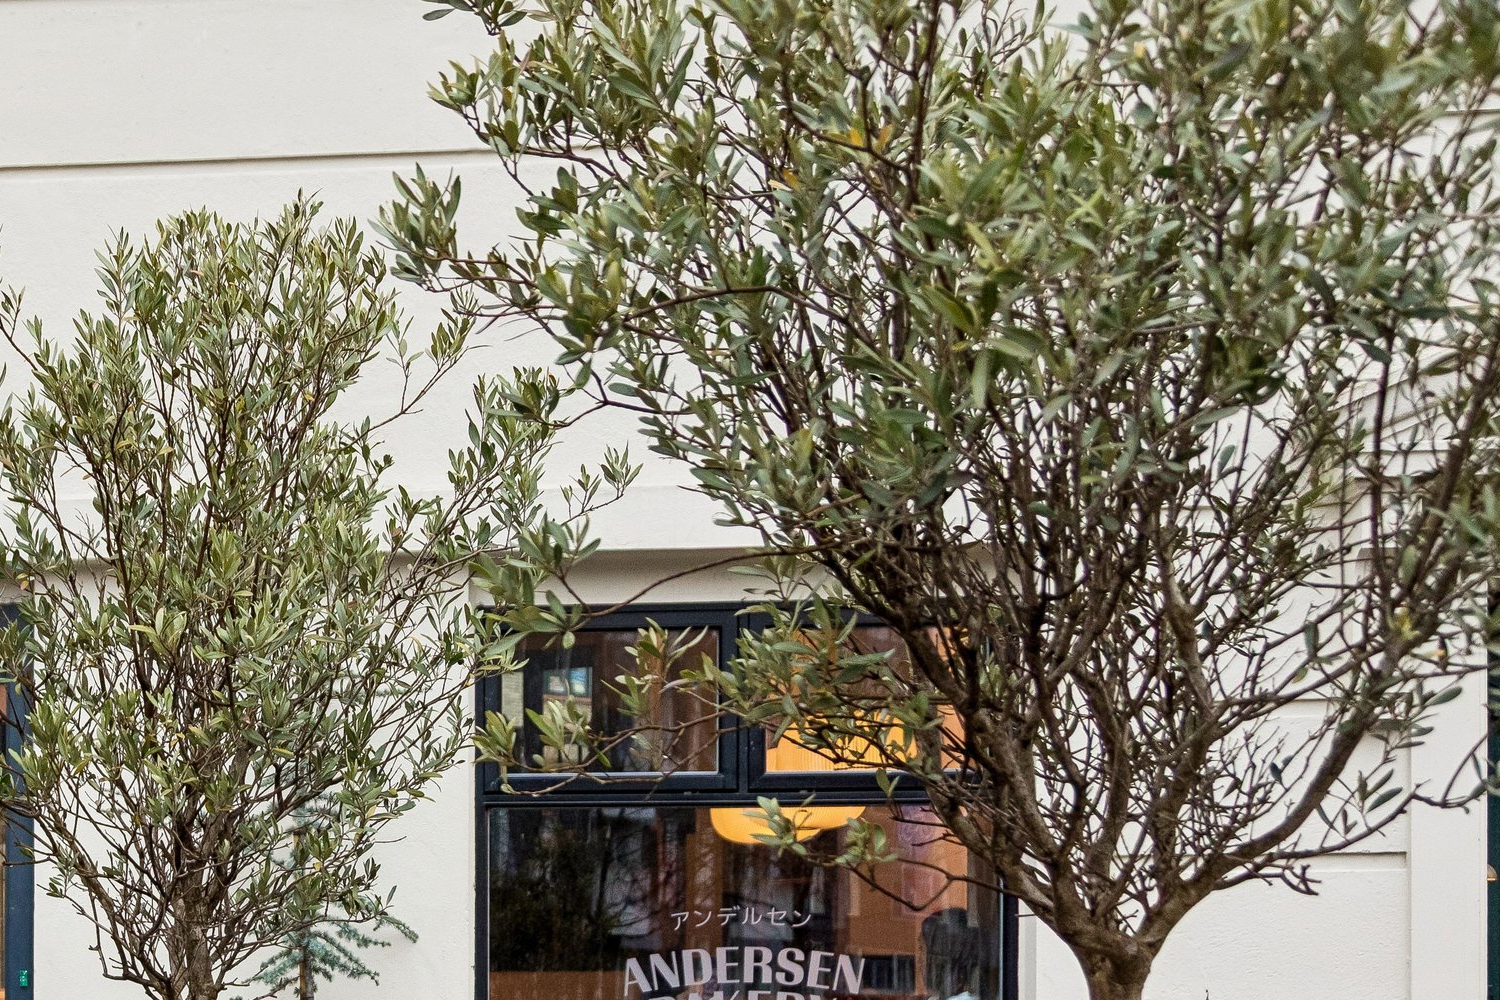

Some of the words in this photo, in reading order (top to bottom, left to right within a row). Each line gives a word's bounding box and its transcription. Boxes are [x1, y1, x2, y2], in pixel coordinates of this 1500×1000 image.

[670, 904, 812, 931] アンデルセン
[623, 946, 866, 997] ANDERSEN
